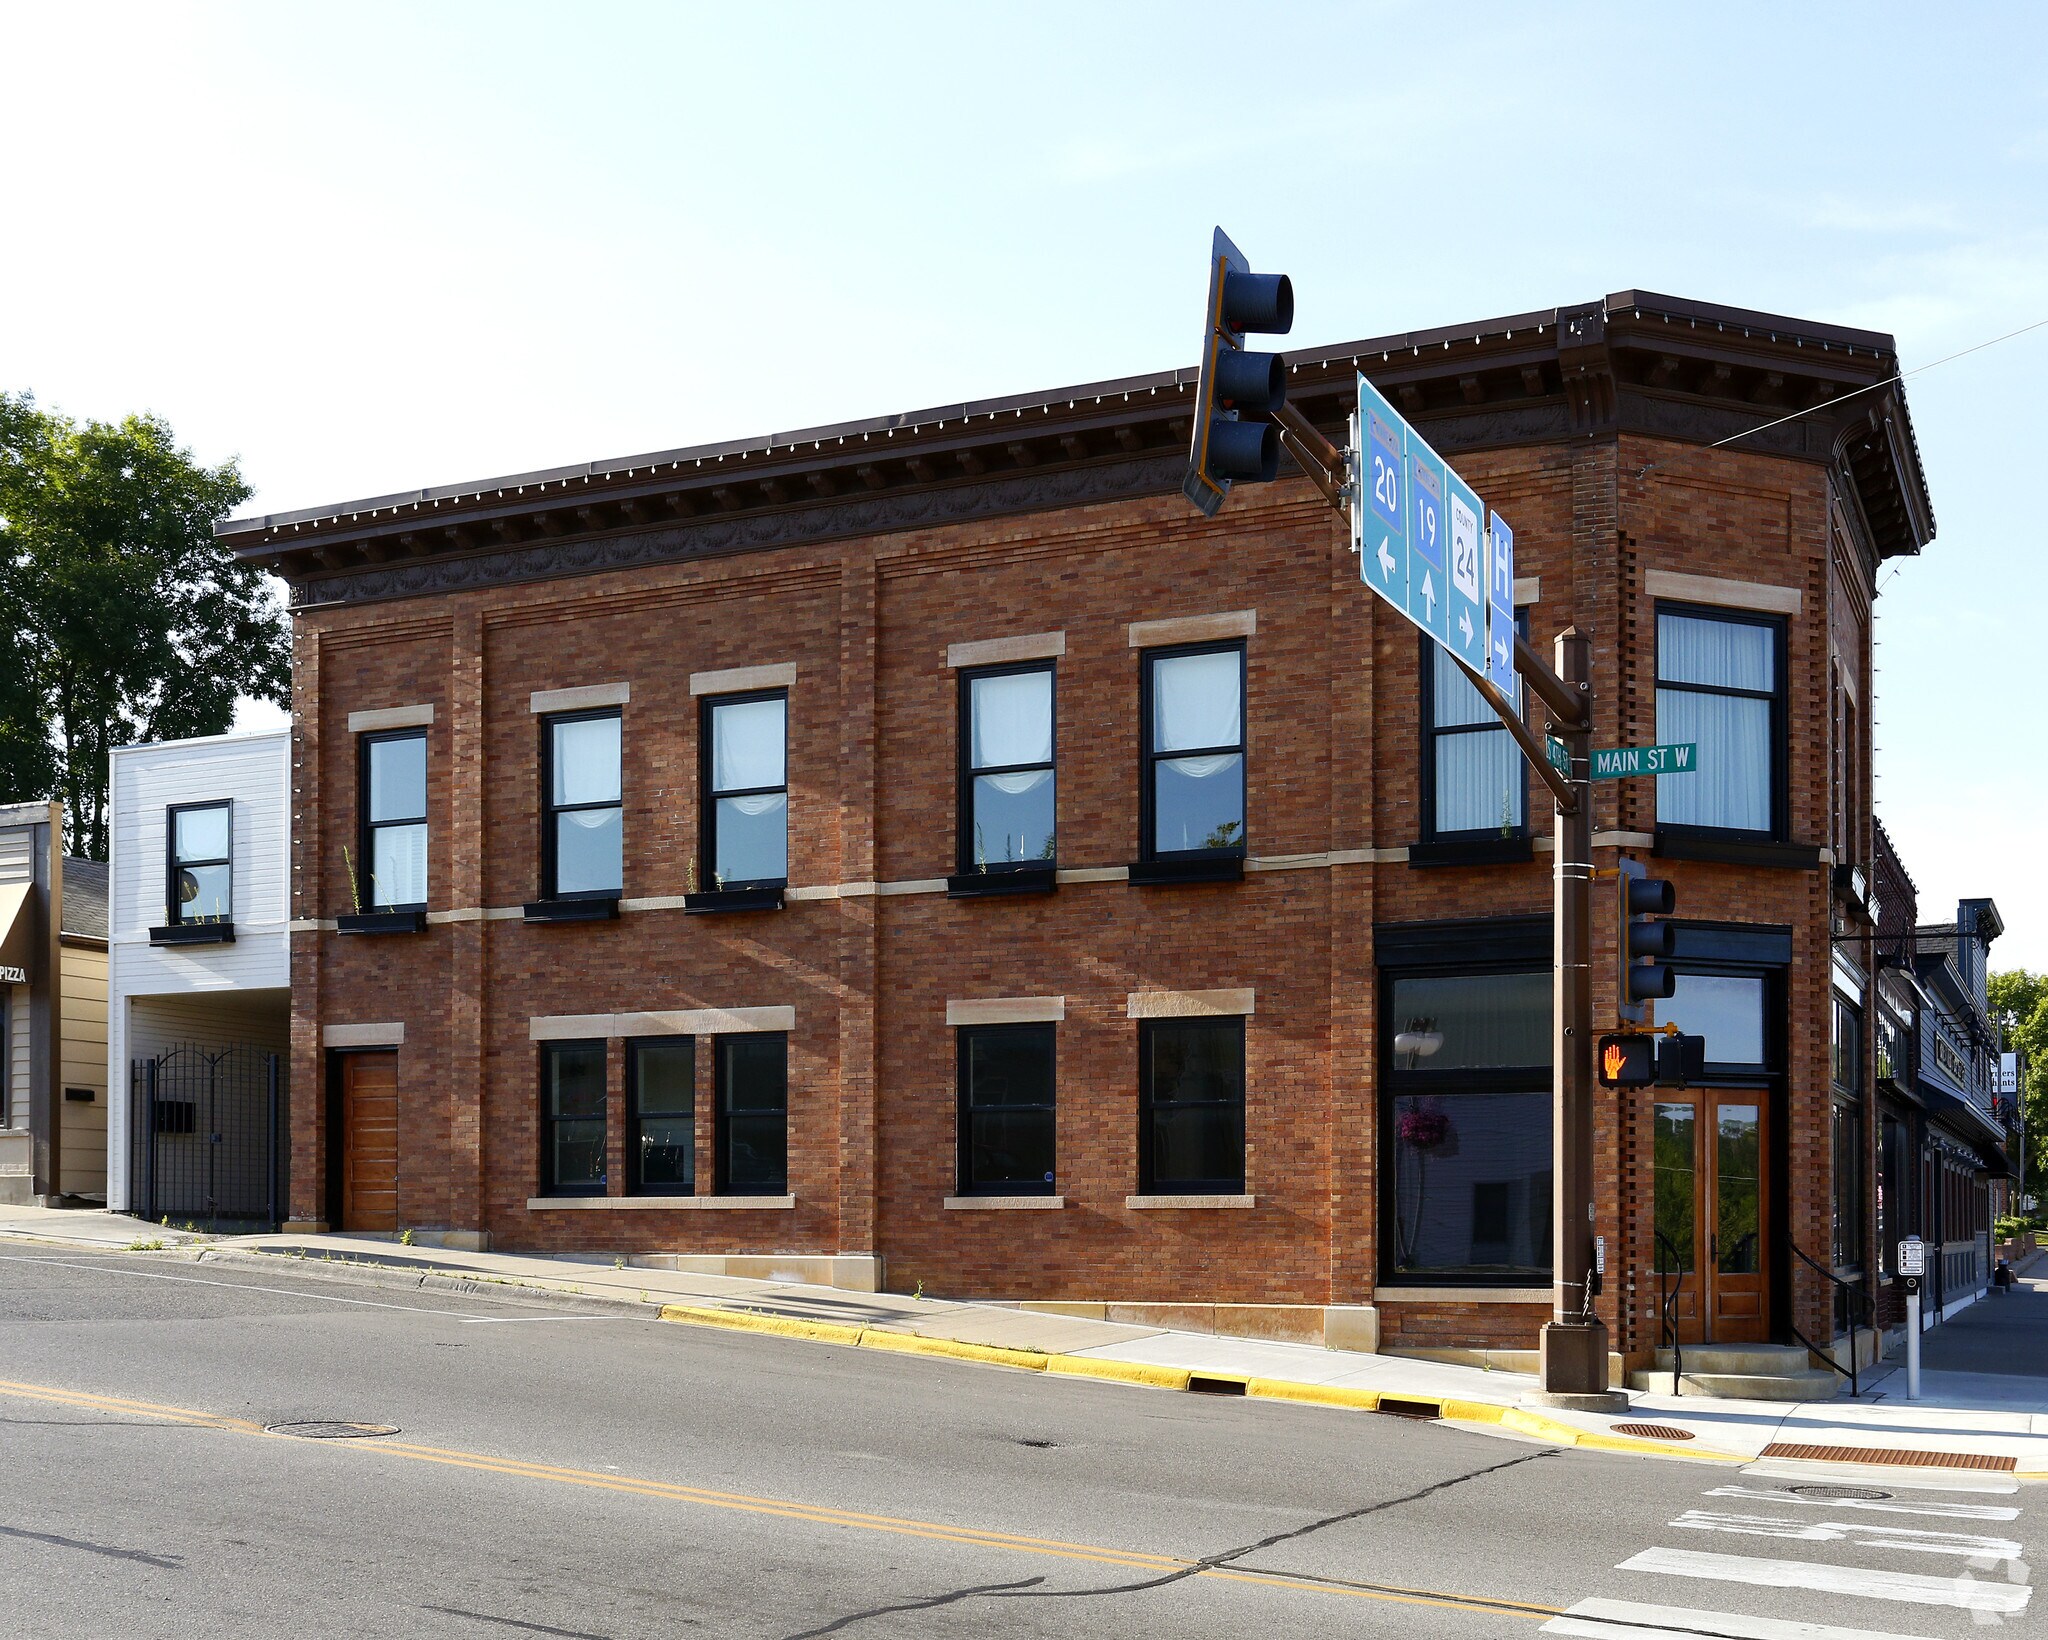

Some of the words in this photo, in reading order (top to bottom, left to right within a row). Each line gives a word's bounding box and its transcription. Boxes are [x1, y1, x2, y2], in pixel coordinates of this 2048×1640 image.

[1375, 455, 1397, 512] 20
[1419, 498, 1436, 547] 19
[1456, 507, 1474, 534] COUNTY
[1456, 536, 1475, 587] 24
[1495, 531, 1509, 600] H
[1597, 750, 1640, 773] MAIN
[1647, 748, 1668, 770] ST
[1675, 746, 1690, 768] W
[0, 965, 26, 983] PIZZA
[1991, 1077, 2015, 1086] hnts
